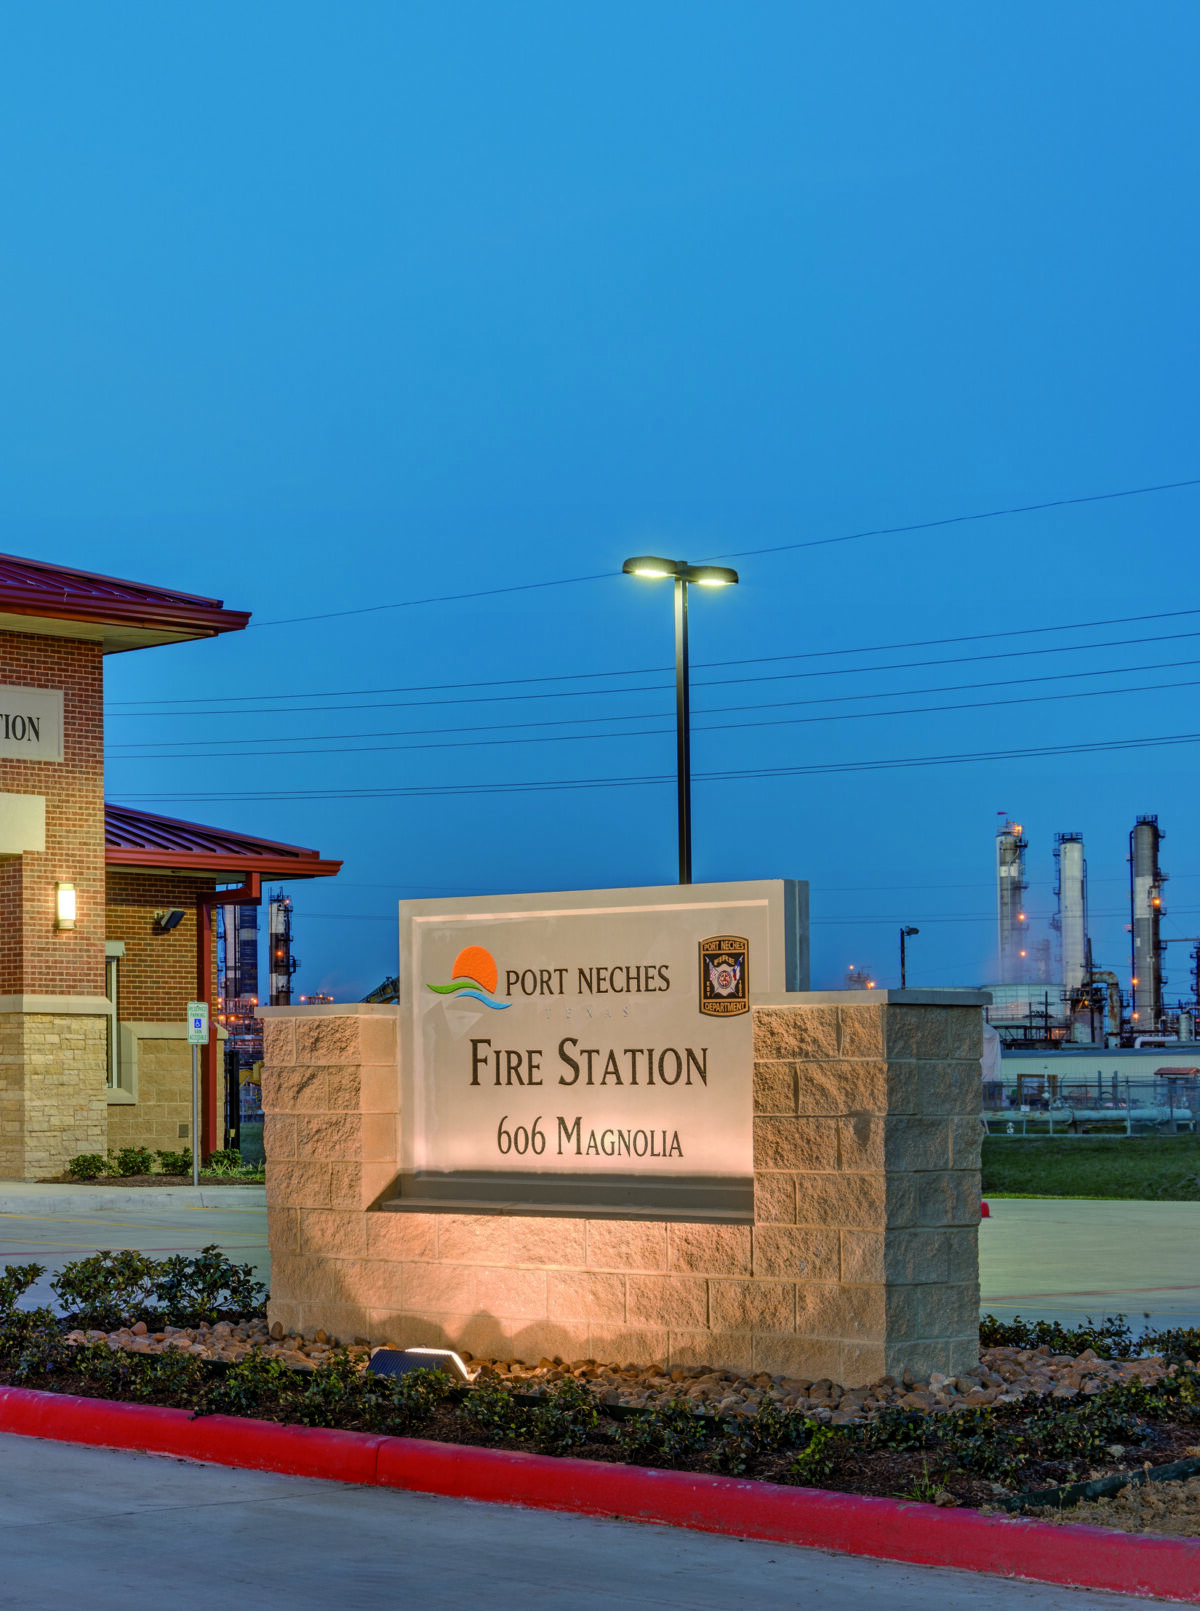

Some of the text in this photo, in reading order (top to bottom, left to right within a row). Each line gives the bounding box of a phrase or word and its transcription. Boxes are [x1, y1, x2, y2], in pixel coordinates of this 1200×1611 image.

[704, 940, 745, 951] PORT NECHES
[713, 954, 735, 966] FIRE
[505, 964, 671, 996] PORT NECHES
[704, 1002, 745, 1013] DEPARTMENT
[469, 1036, 709, 1088] FIRE STATION
[496, 1115, 685, 1158] 606 MAGNOLIA
